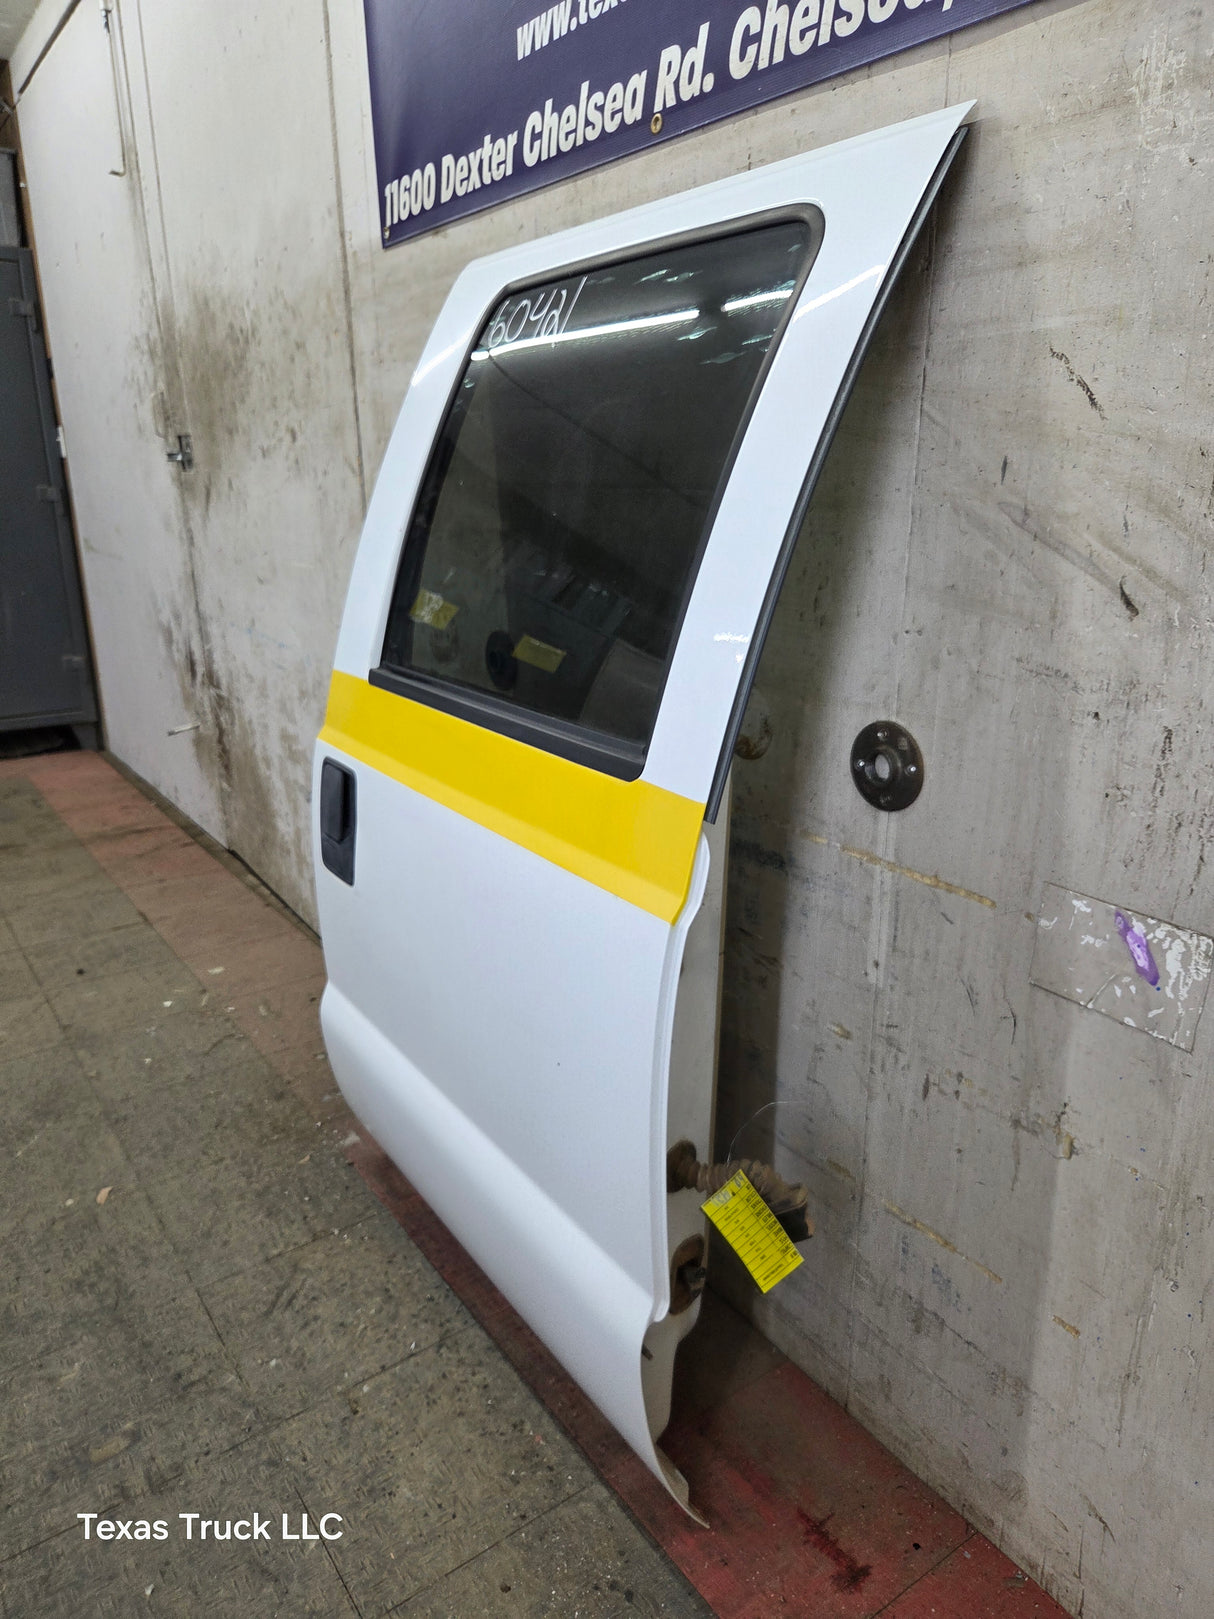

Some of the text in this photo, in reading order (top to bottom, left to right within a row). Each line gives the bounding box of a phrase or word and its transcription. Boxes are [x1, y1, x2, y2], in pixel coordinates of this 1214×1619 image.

[384, 162, 436, 228] 11600
[440, 130, 518, 203] Dexter
[522, 69, 648, 167] Chelsea
[653, 21, 715, 114] Rd.
